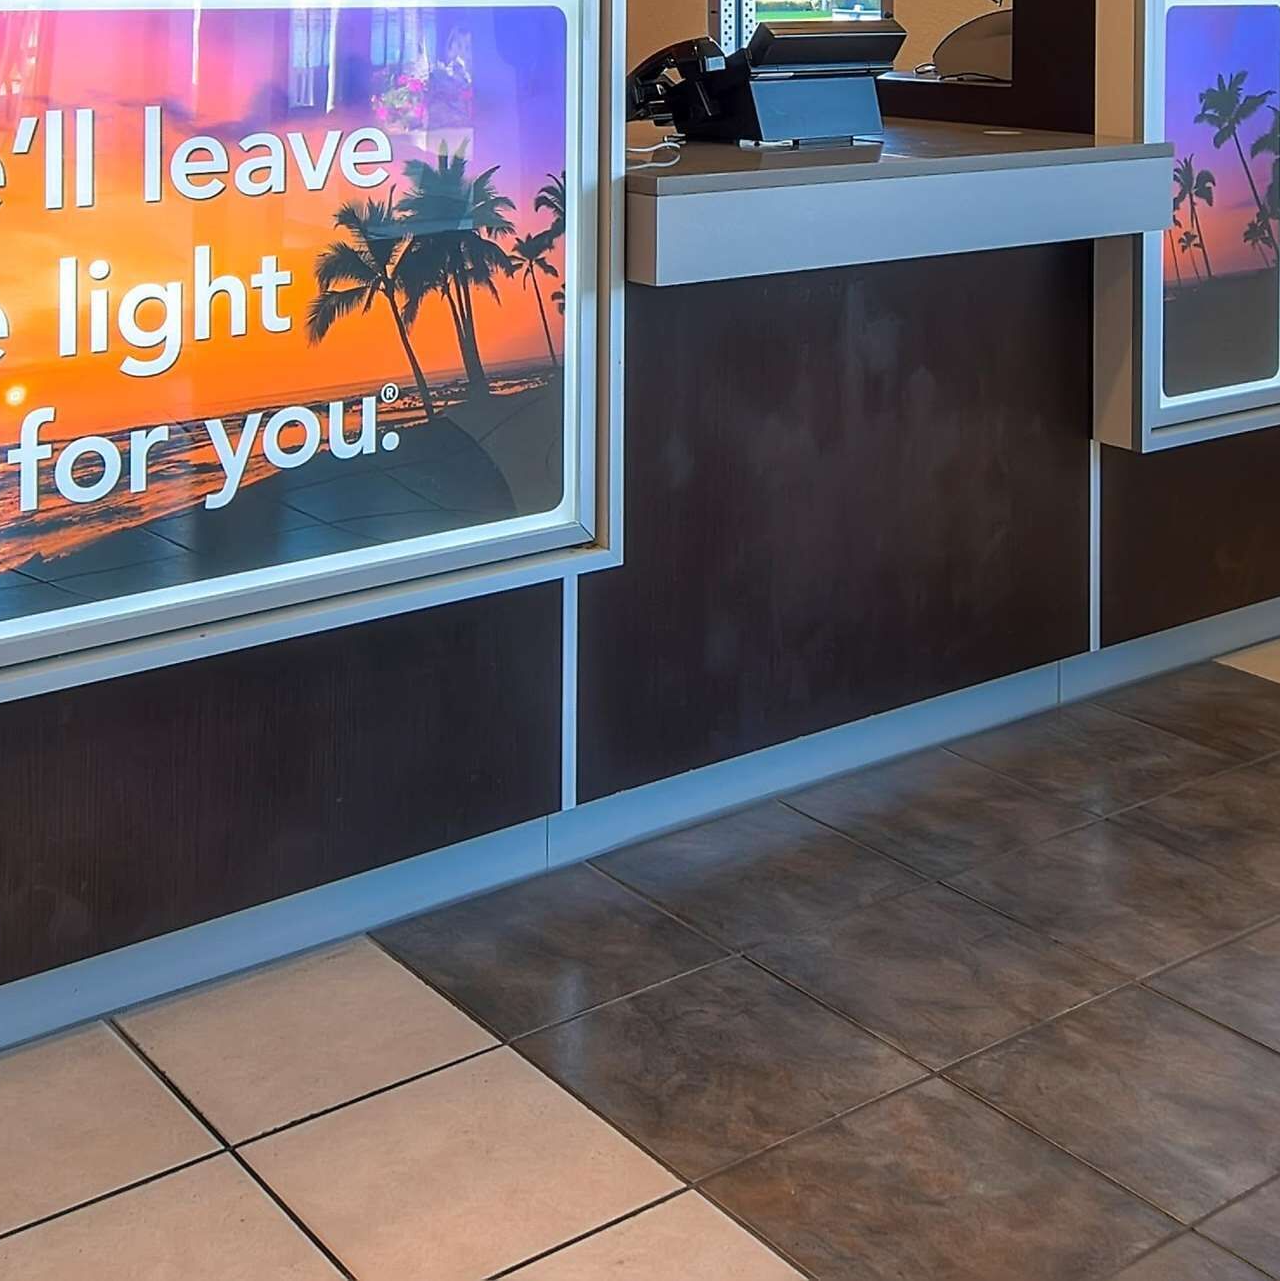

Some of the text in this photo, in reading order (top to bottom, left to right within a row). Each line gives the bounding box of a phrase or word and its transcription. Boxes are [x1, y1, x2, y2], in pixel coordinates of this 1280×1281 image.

[142, 105, 395, 205] leave
[57, 245, 293, 379] light
[5, 405, 170, 512] for
